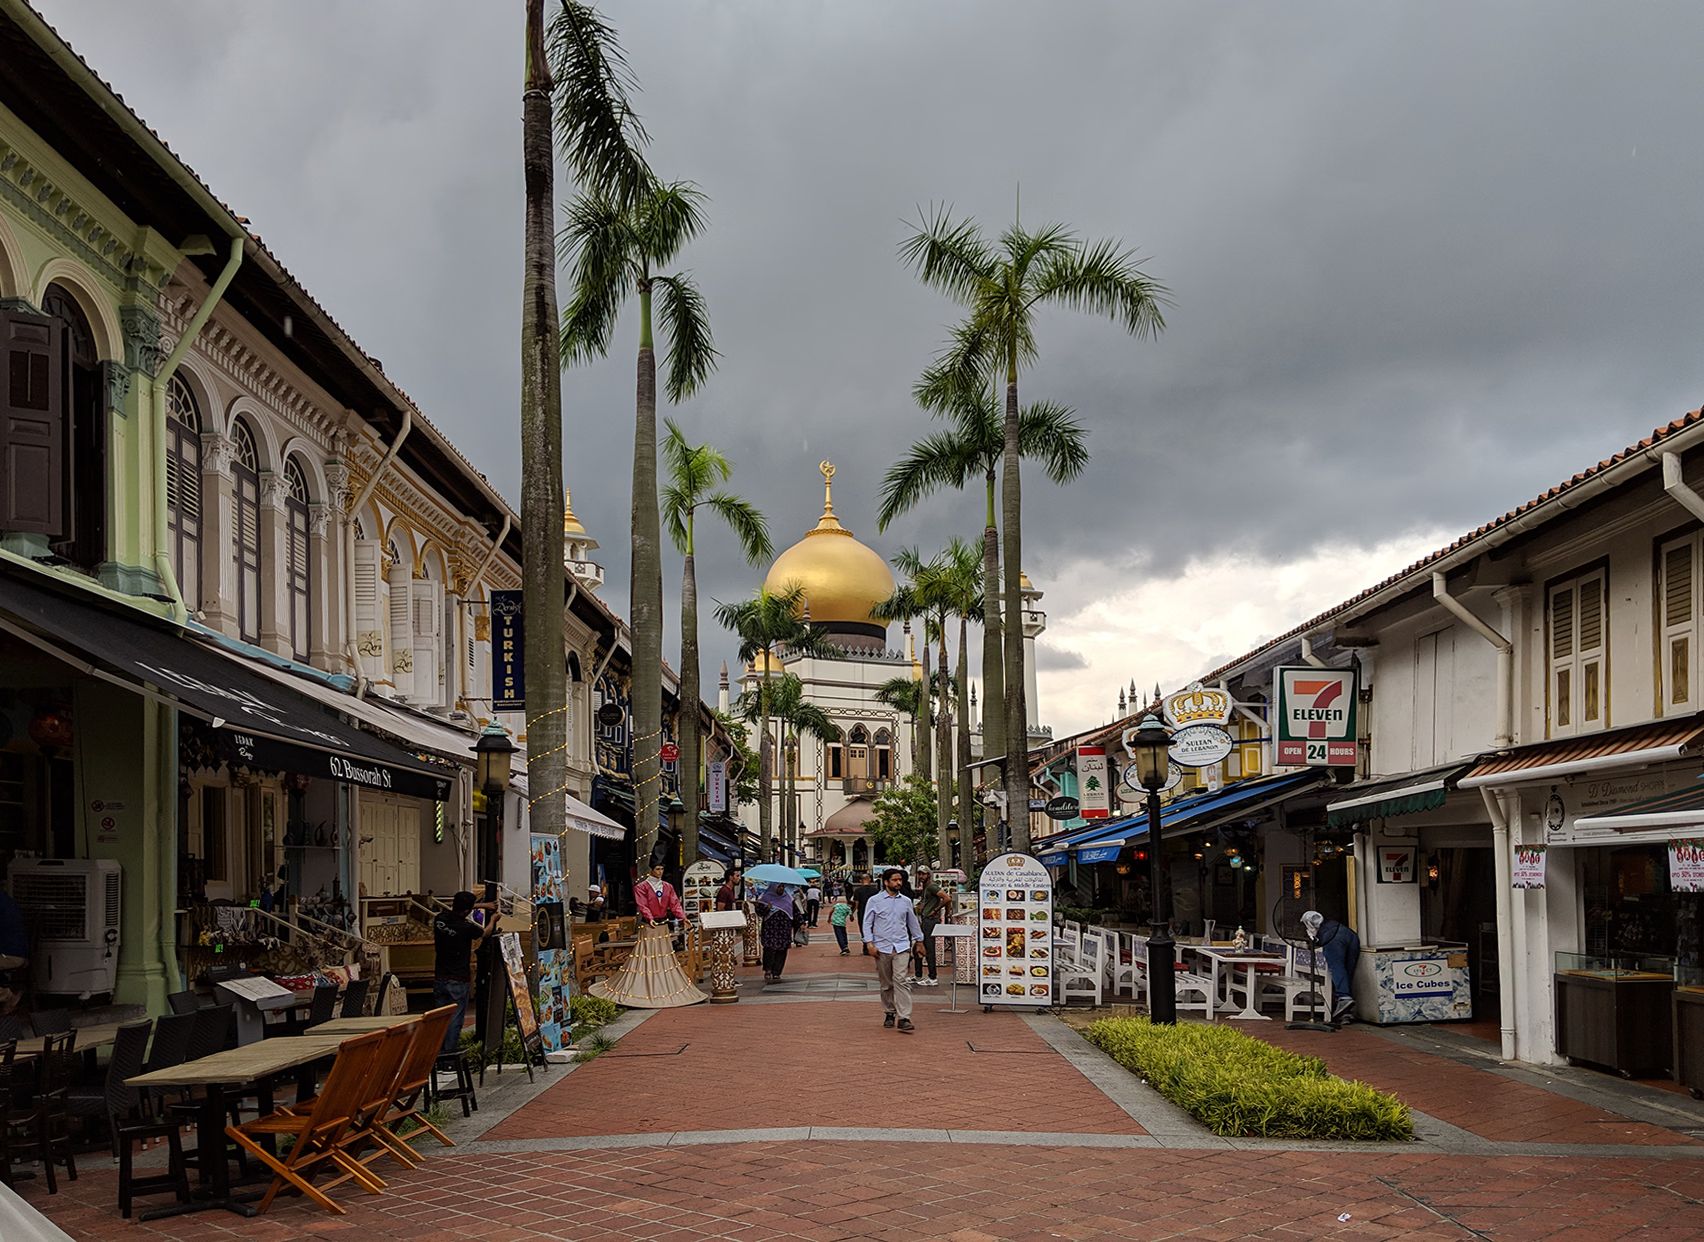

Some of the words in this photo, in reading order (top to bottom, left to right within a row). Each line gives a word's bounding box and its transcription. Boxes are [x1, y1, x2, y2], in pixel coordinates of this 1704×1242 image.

[503, 616, 515, 698] TURKISH
[1186, 739, 1212, 747] SULTAN
[1284, 747, 1302, 755] OPEN
[1307, 744, 1327, 760] 24
[1329, 747, 1354, 756] HOURS
[329, 756, 343, 777] 62
[342, 759, 383, 786] Bussorah
[382, 769, 392, 788] St
[1601, 780, 1639, 797] Diamond
[1416, 980, 1450, 988] Cubes
